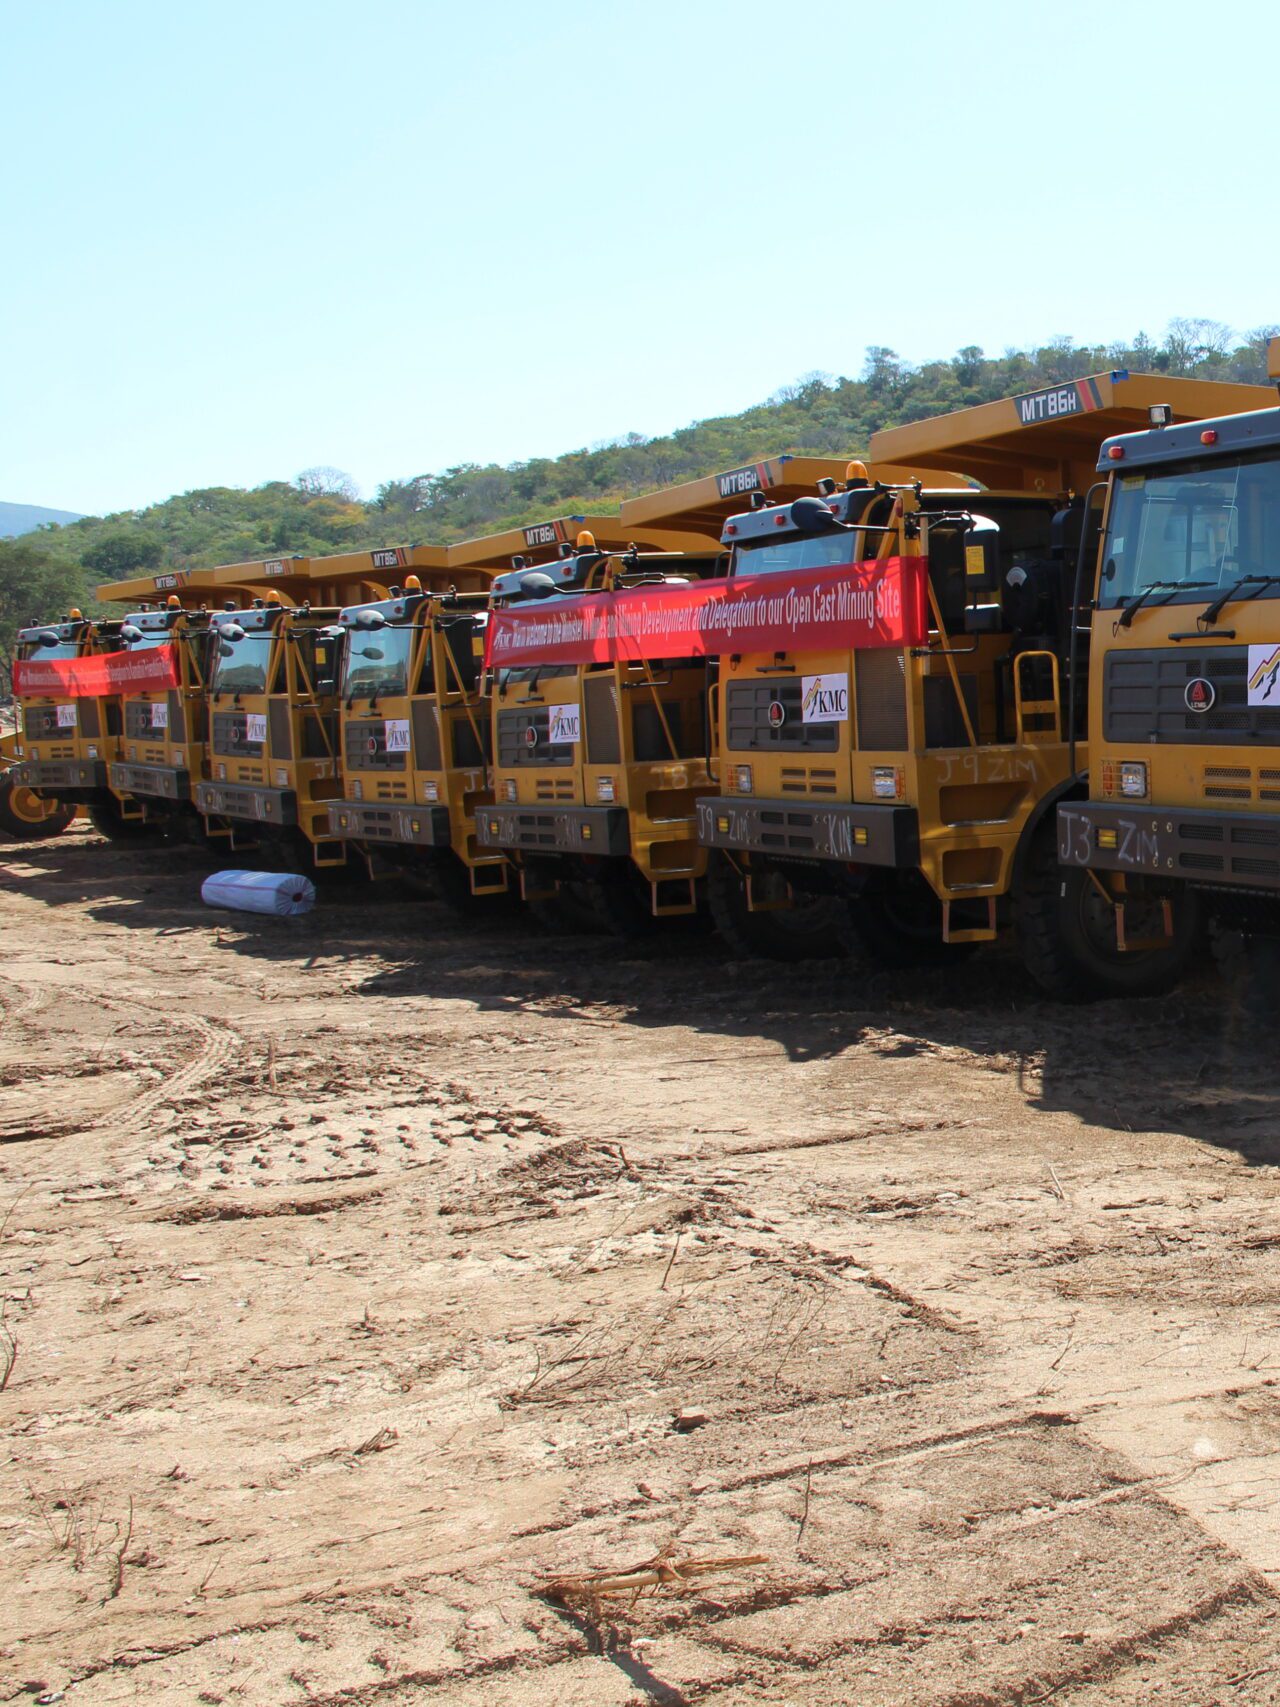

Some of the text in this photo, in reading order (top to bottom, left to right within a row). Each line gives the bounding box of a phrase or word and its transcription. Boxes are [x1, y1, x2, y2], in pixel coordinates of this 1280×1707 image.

[1022, 390, 1076, 422] MT86H
[721, 471, 757, 496] MT86H
[526, 526, 556, 546] MT86H
[618, 602, 641, 644] Mining
[641, 600, 693, 641] Development
[693, 600, 709, 631] and
[708, 593, 755, 637] Delegation
[757, 595, 766, 627] to
[768, 598, 784, 625] our
[786, 586, 811, 632] Open
[813, 584, 836, 623] Cast
[837, 580, 874, 629] Mining
[876, 577, 900, 619] Site
[819, 689, 846, 713] KMC
[560, 717, 579, 736] KMC
[936, 753, 1038, 784] J9 ZIM
[695, 803, 715, 843] J9
[827, 814, 853, 858] KIN
[1058, 809, 1092, 865] J3
[1118, 818, 1160, 865] ZIM
